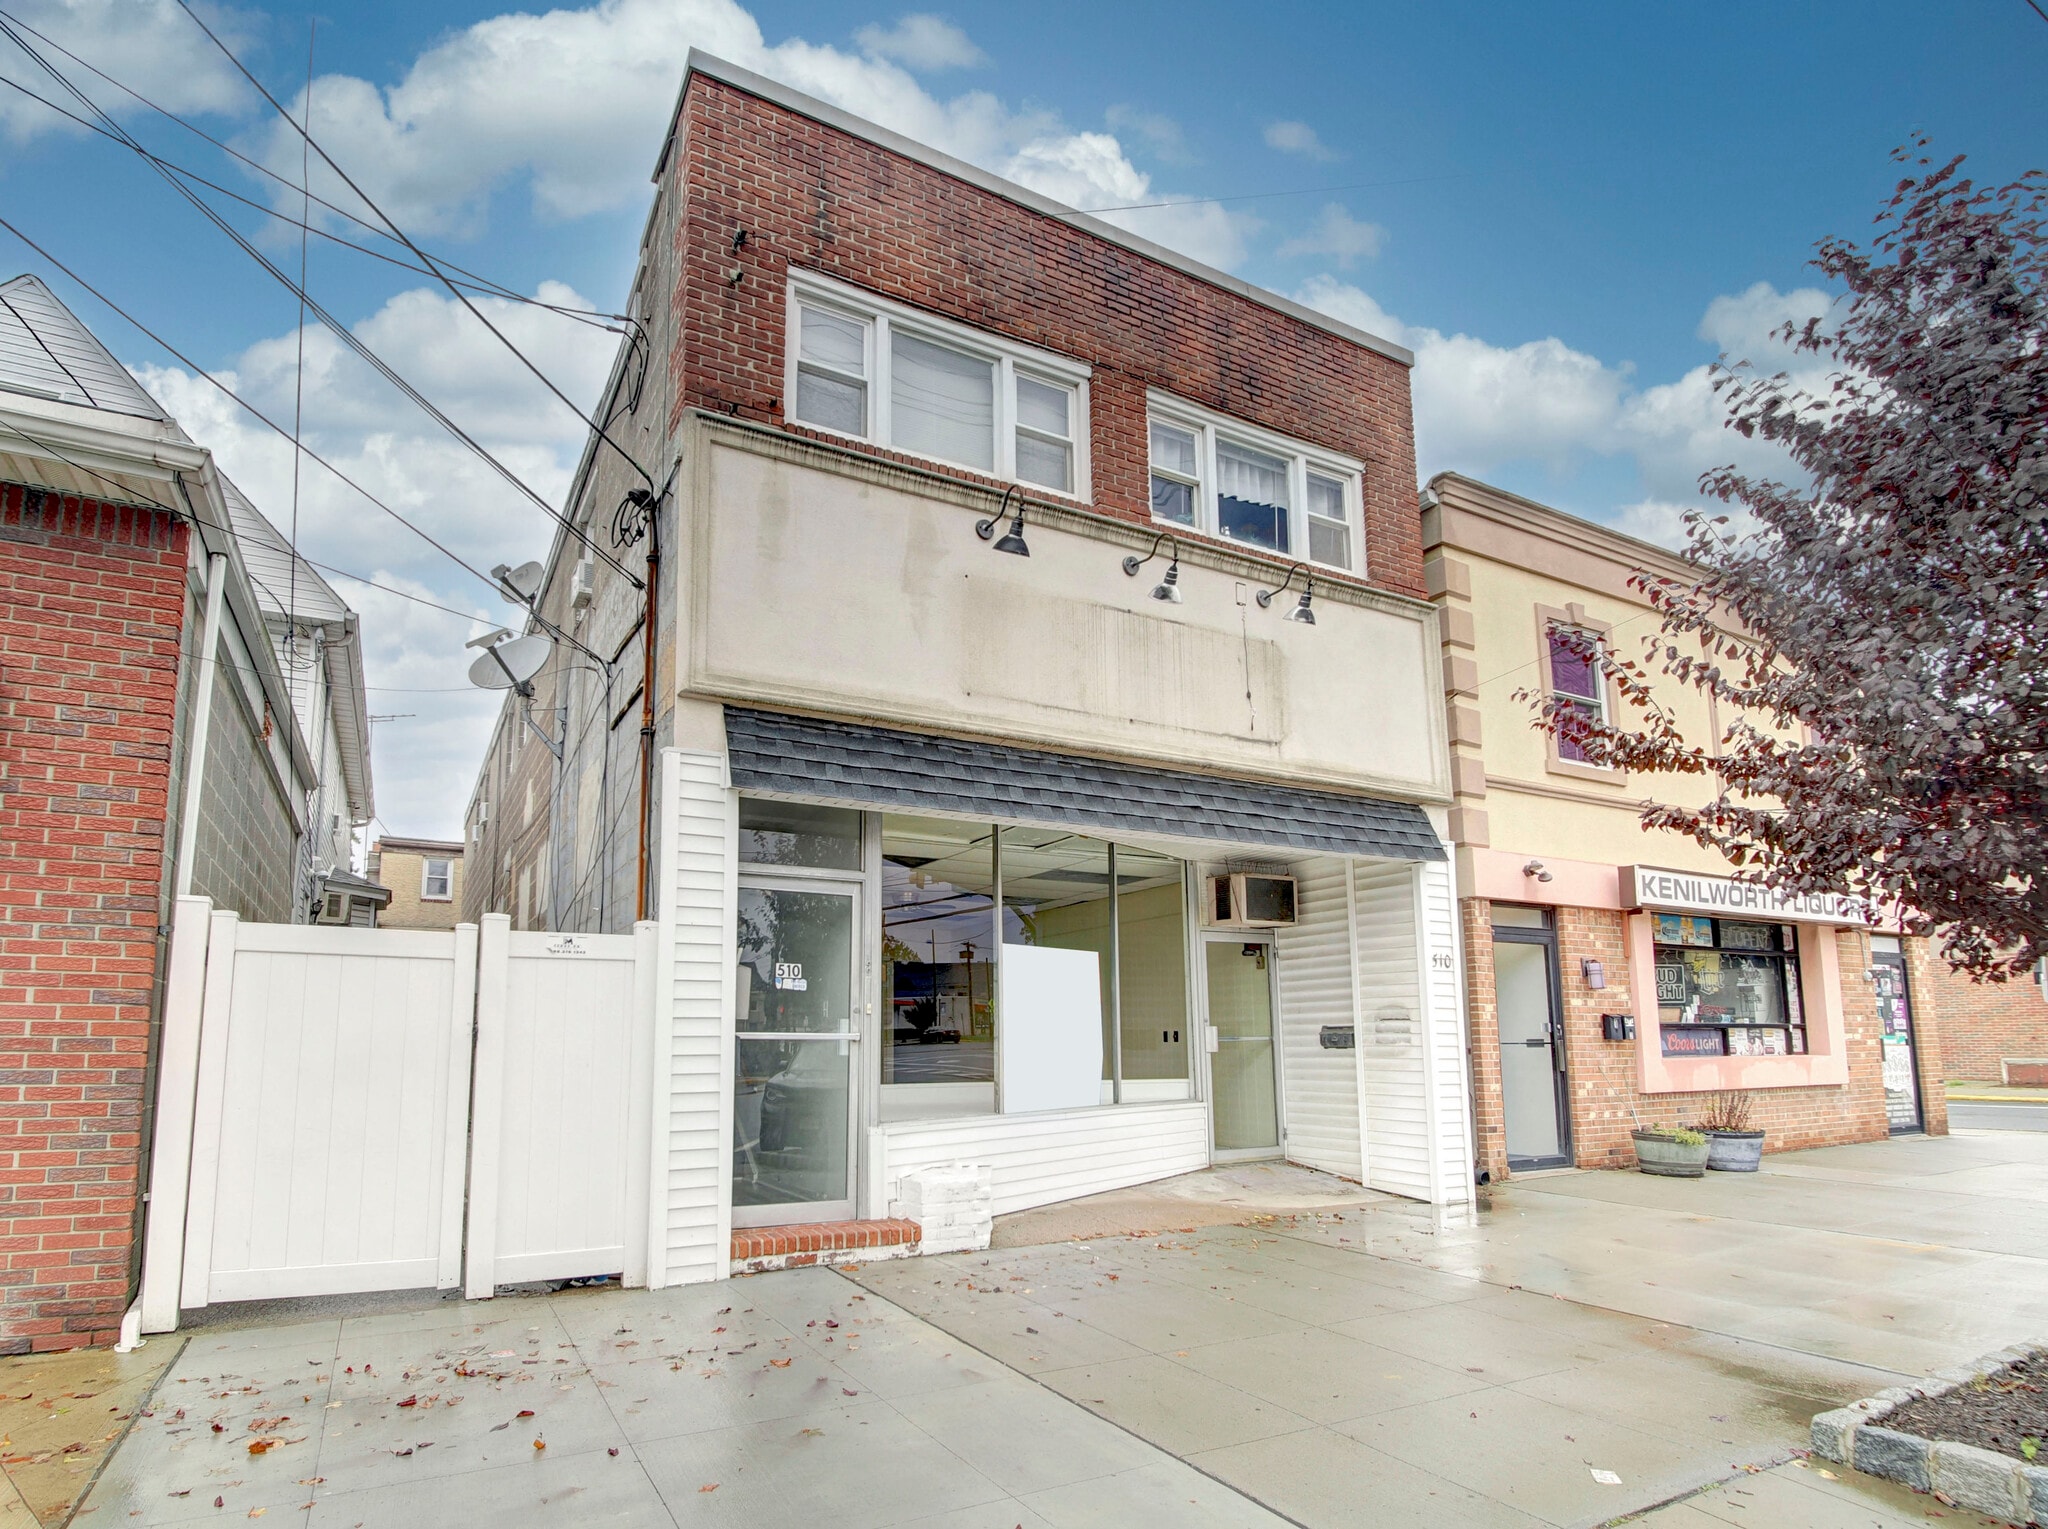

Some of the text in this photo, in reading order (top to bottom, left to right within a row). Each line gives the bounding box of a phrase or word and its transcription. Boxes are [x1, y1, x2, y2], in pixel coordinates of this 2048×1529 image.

[1642, 875, 1870, 921] KENILWORTH LIQUOR
[1432, 953, 1451, 968] 510
[777, 964, 800, 977] 510
[1656, 967, 1677, 984] UD
[1667, 1033, 1719, 1051] Coors LIGHT
